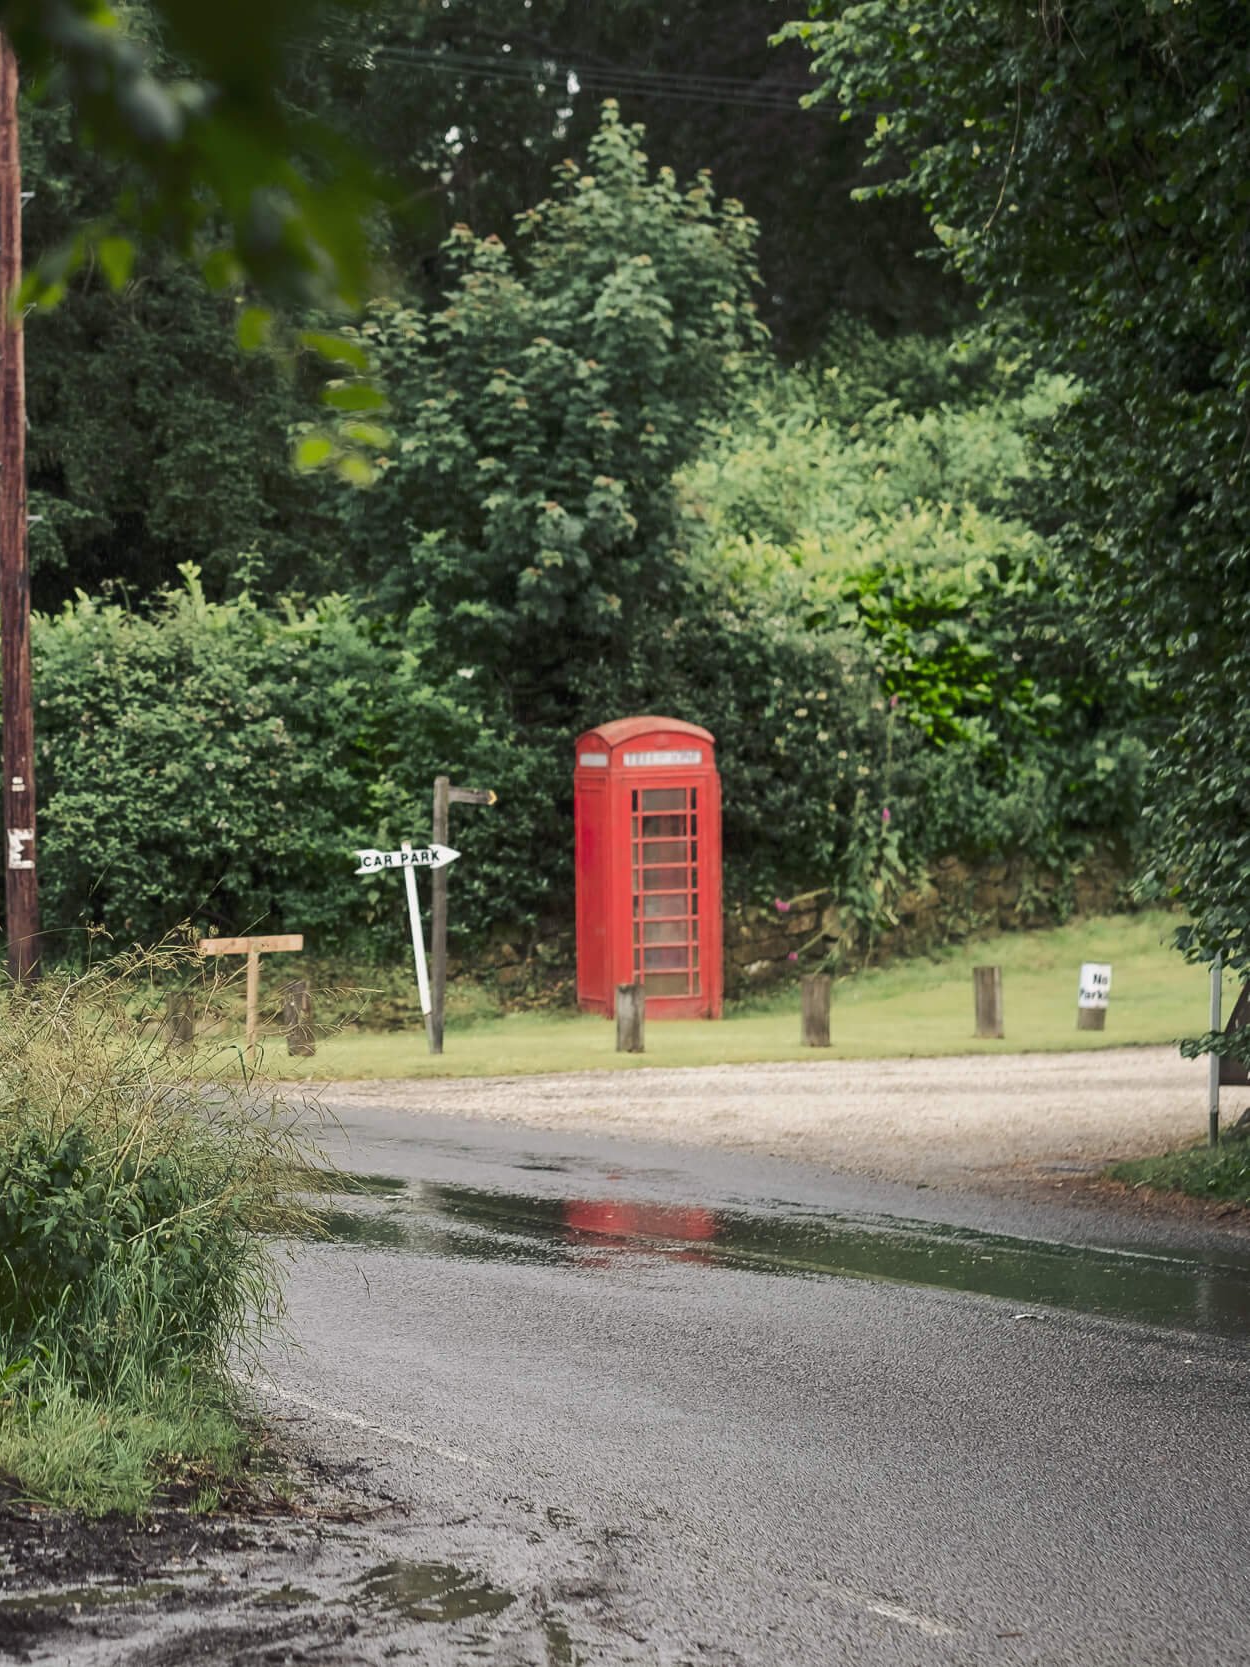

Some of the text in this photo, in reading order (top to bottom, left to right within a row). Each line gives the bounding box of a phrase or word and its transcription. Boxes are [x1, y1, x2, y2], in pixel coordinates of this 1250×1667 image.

[363, 850, 440, 867] CAR PARK
[1093, 973, 1108, 985] No
